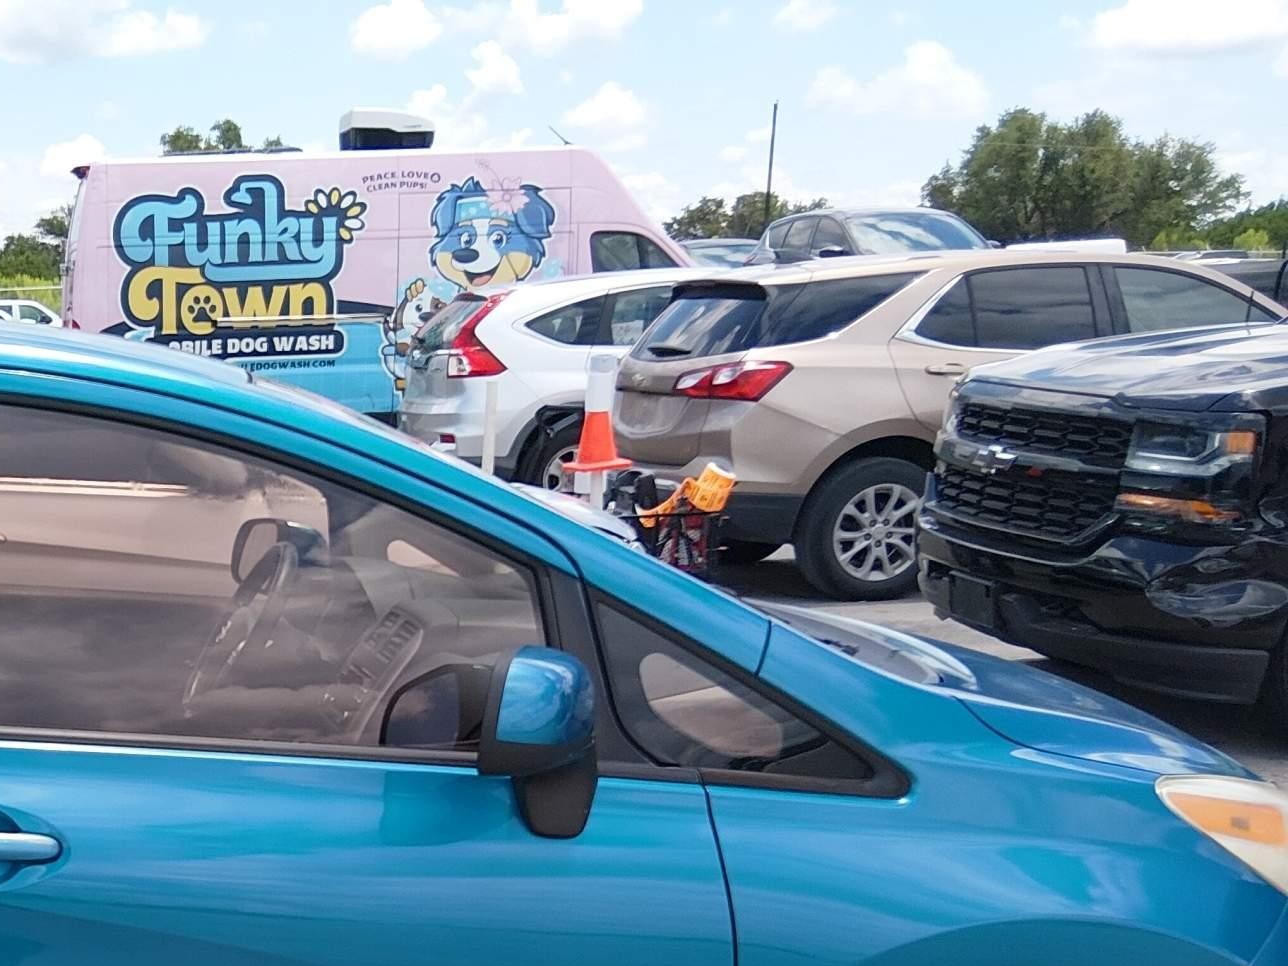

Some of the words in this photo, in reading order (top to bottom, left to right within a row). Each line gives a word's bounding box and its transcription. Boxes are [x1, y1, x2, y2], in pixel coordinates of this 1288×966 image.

[401, 170, 429, 180] LOVE
[366, 182, 397, 193] CLEAN
[120, 180, 339, 282] Funky
[226, 337, 268, 354] DOG
[273, 334, 335, 352] WASH
